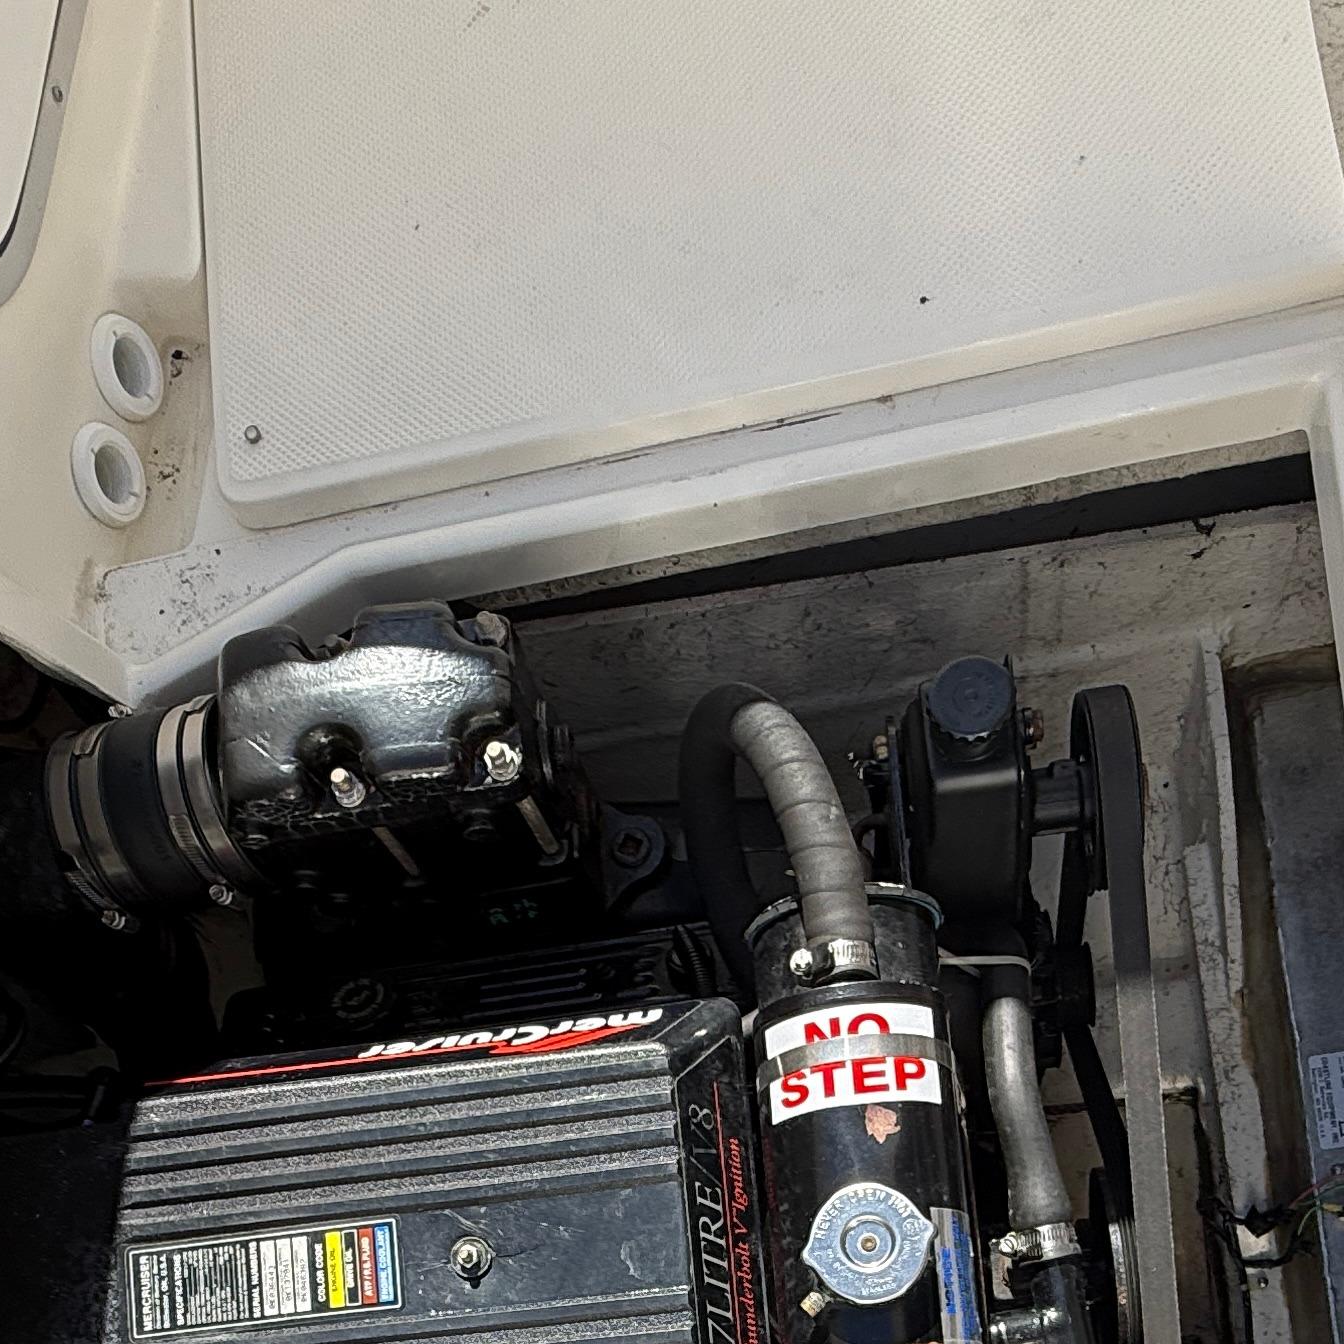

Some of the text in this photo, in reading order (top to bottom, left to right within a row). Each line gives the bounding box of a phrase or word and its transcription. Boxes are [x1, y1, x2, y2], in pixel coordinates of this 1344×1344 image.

[358, 1008, 663, 1059] merCruiser
[781, 1056, 926, 1108] STEP
[728, 1136, 749, 1213] Ignition
[139, 1255, 154, 1332] MERCRUISER
[314, 1242, 326, 1302] COLOR CODE
